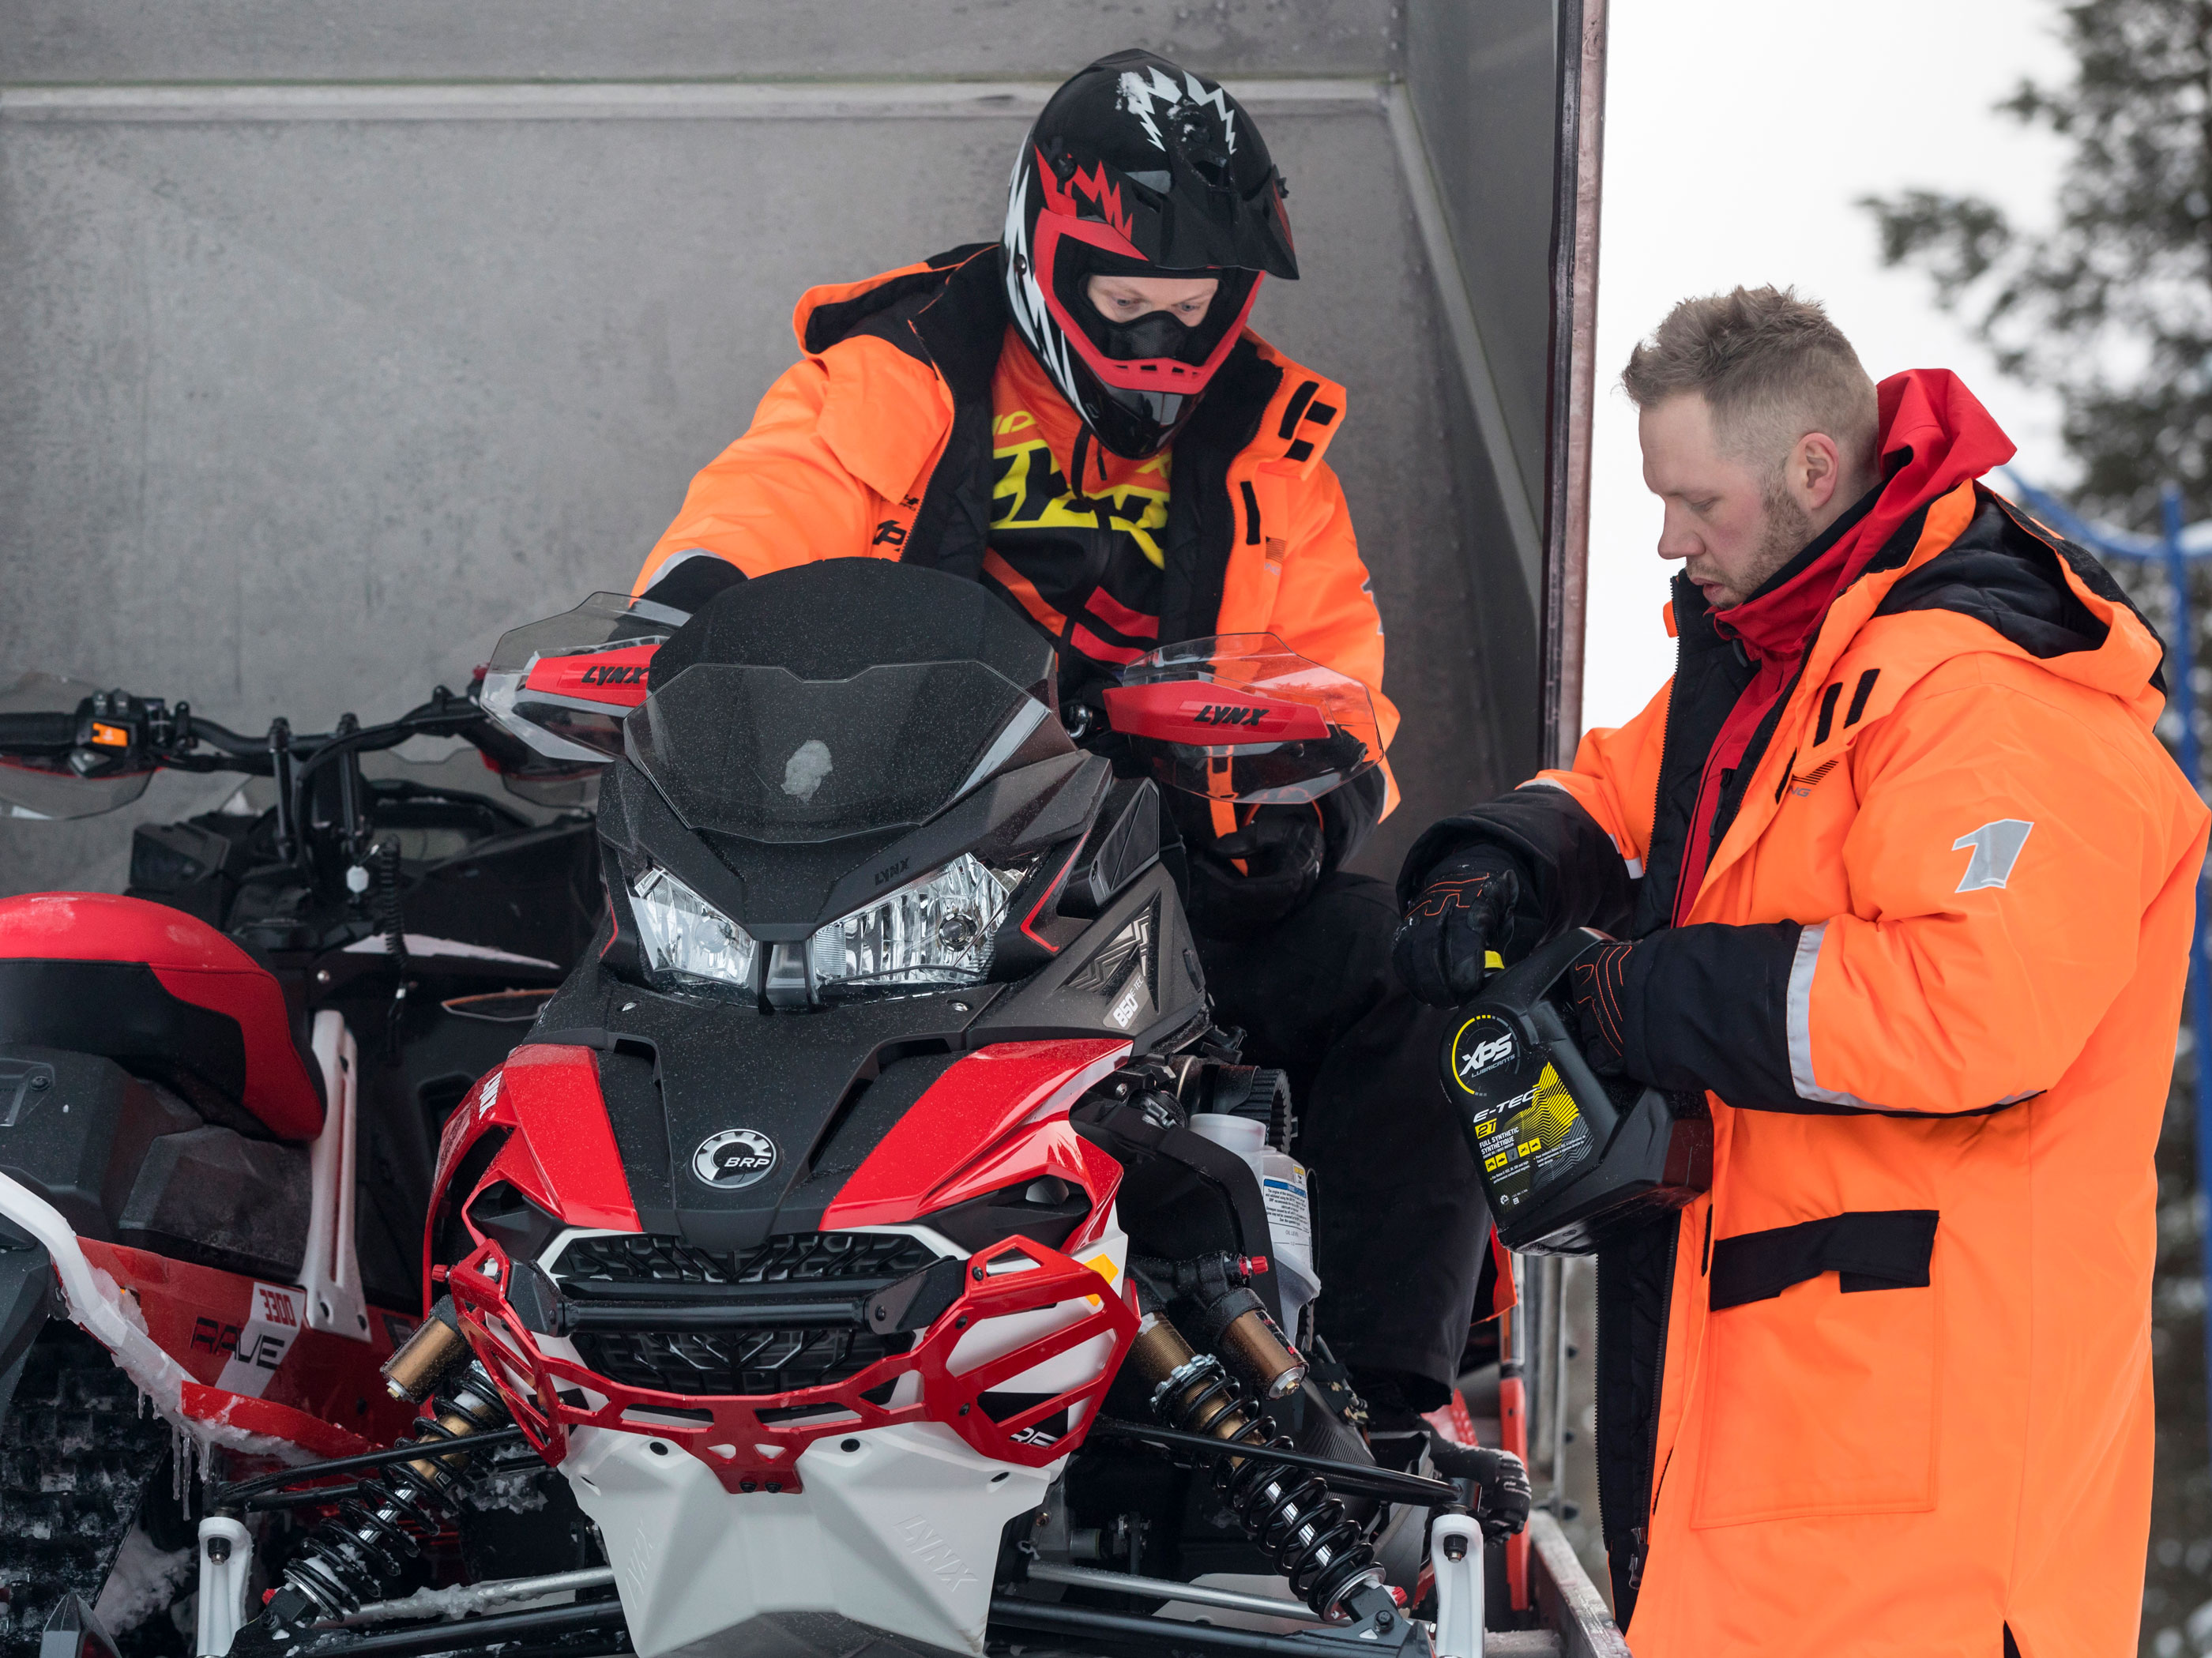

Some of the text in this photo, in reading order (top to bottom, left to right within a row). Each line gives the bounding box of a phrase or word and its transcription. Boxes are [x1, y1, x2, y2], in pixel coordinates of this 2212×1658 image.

[581, 666, 650, 686] LYNX
[1193, 705, 1270, 726] LYNX
[1951, 818, 2034, 893] 1
[875, 856, 909, 885] LYNX
[1113, 993, 1138, 1028] 850
[1459, 1032, 1512, 1077] XPS
[1472, 1054, 1515, 1078] LUBRICANTS
[1473, 1088, 1537, 1123] E-TEC
[1478, 1121, 1496, 1137] 2T
[1479, 1126, 1519, 1149] FULL SYNTHETIC
[1480, 1136, 1514, 1155] SYNTHÉTIQUE
[724, 1156, 770, 1167] BRP
[259, 1288, 297, 1327] 3300
[190, 1316, 285, 1370] RAVE
[892, 1514, 980, 1592] LYNX
